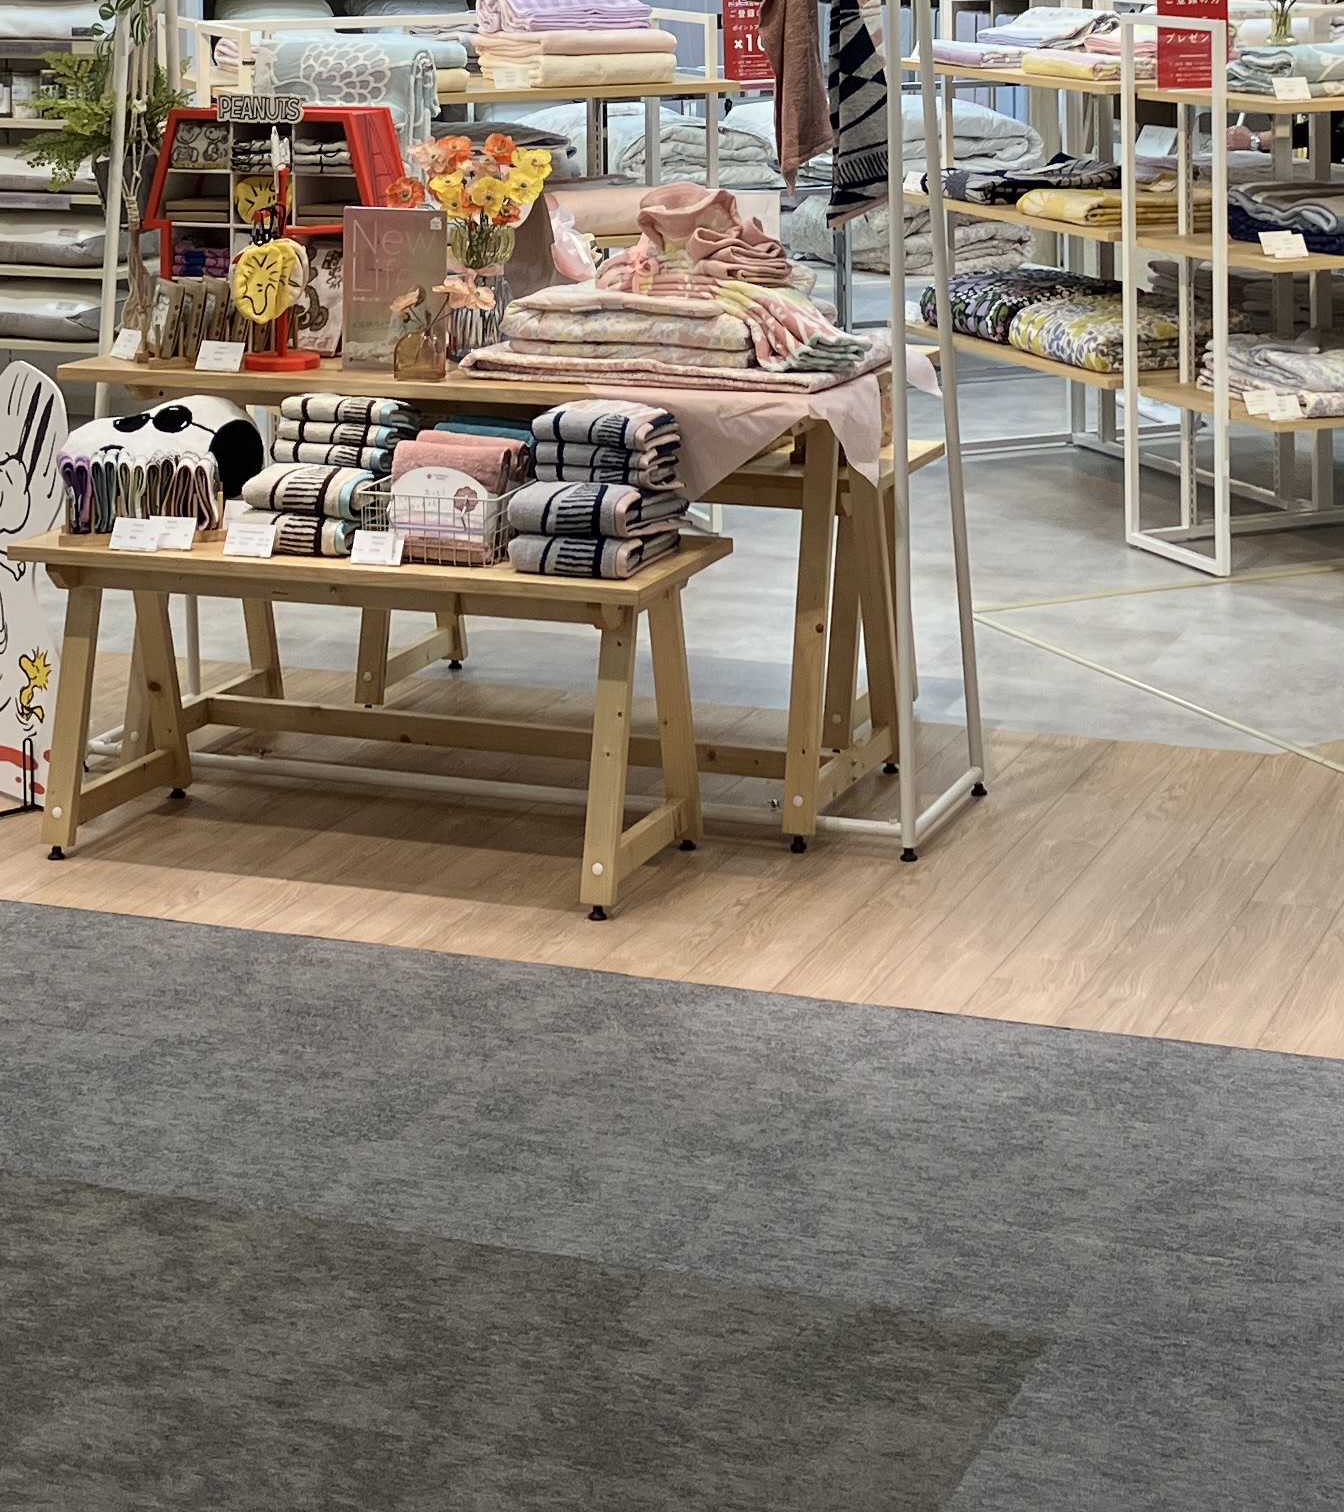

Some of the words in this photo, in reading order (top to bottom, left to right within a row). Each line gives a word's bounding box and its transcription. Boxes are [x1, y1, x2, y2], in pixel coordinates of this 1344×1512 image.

[1165, 32, 1211, 44] プレゼン
[218, 94, 301, 122] PEANUTS
[352, 218, 438, 257] New
